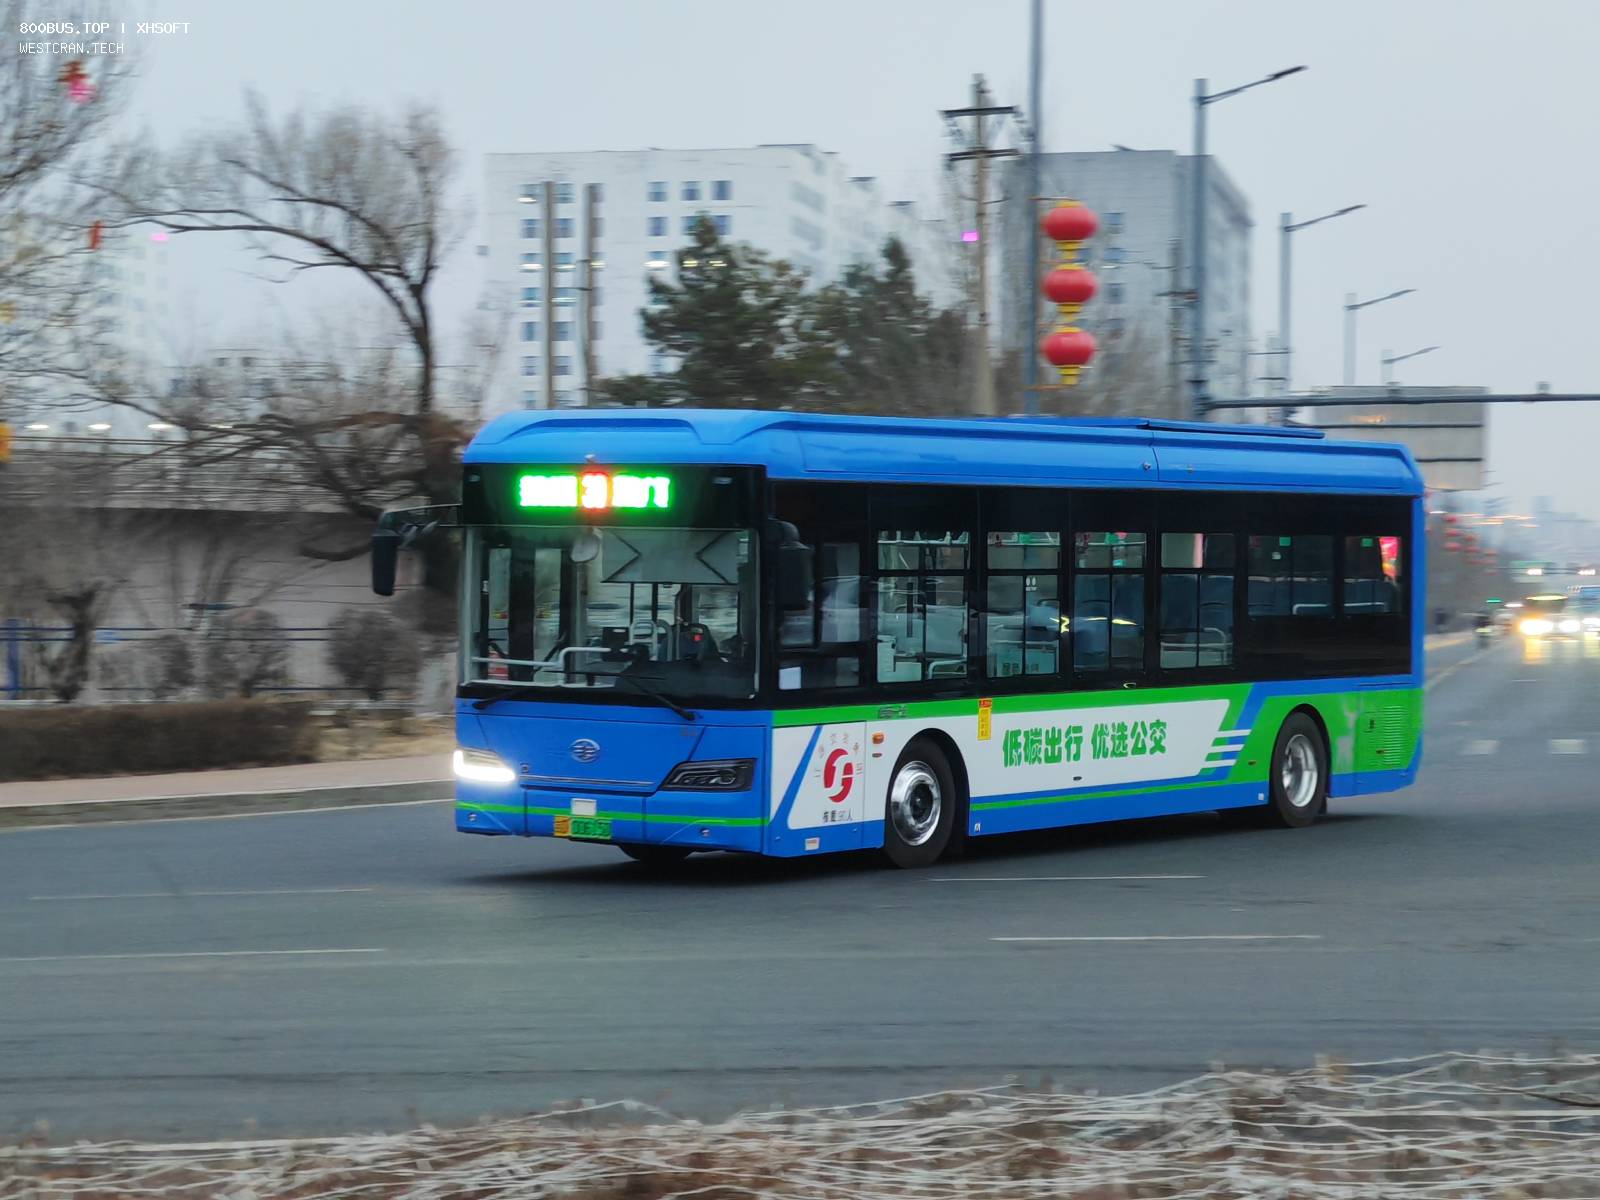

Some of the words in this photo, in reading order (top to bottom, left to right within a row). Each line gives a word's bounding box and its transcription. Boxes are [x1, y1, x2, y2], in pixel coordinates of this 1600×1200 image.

[1003, 725, 1084, 767] 低碳出行
[1090, 719, 1167, 759] 优选公交
